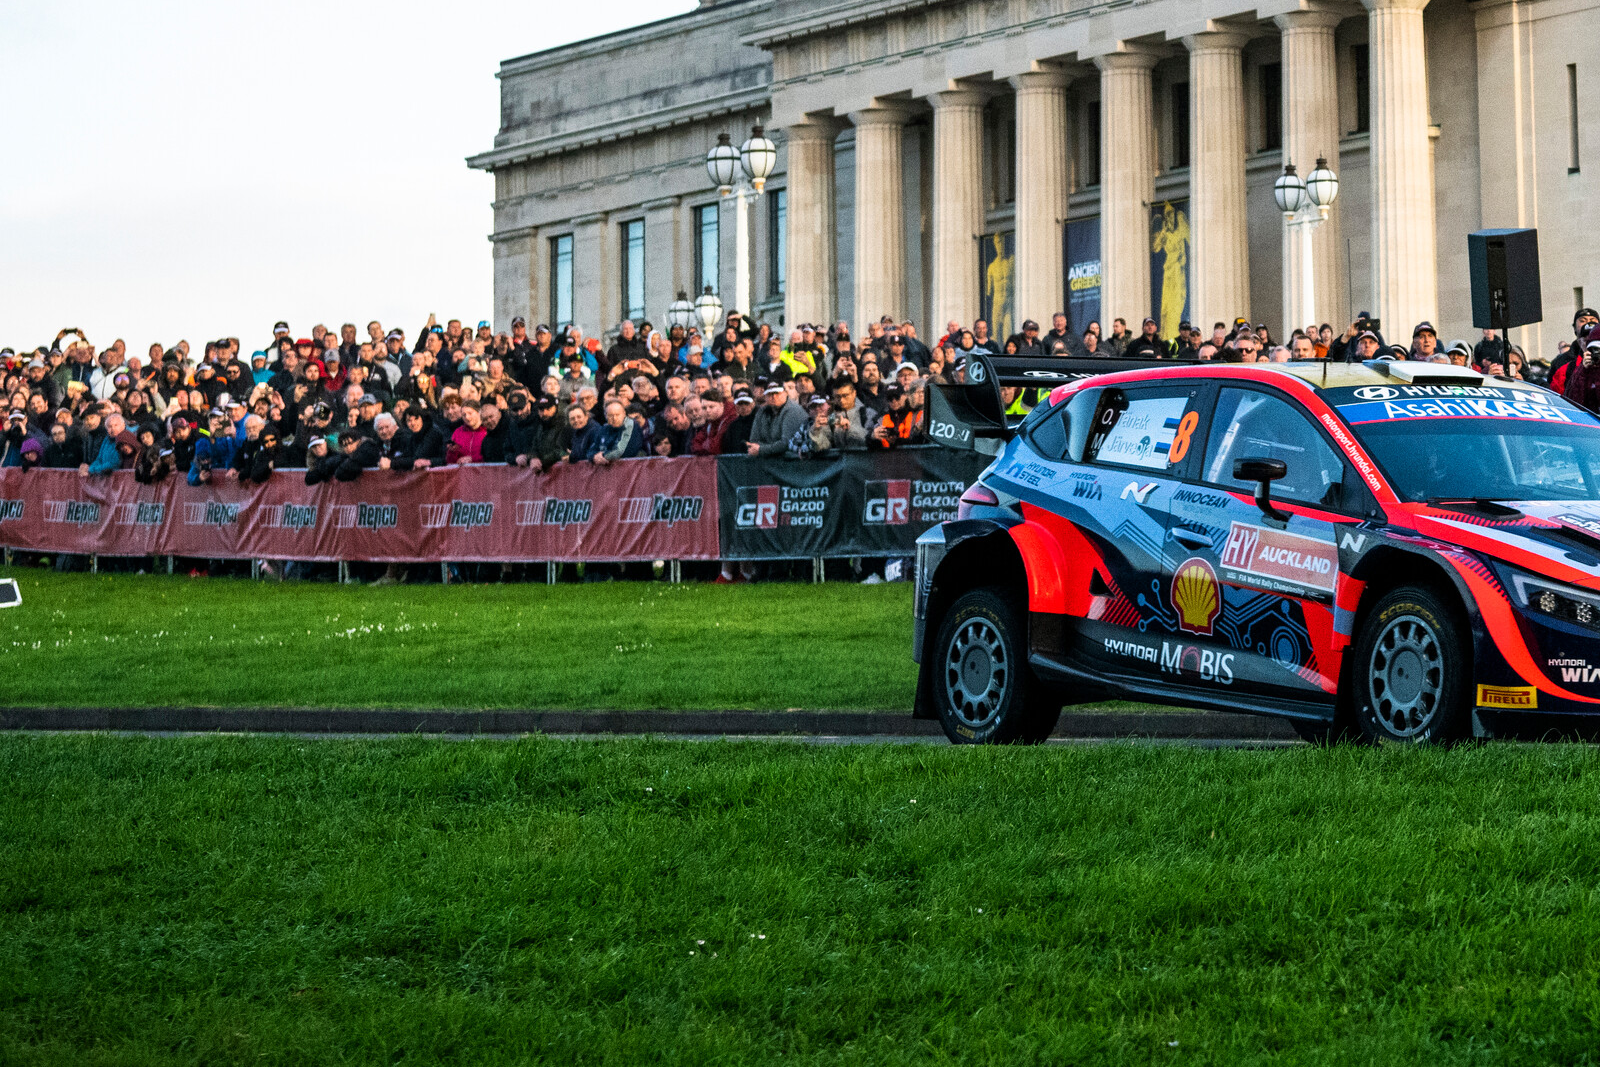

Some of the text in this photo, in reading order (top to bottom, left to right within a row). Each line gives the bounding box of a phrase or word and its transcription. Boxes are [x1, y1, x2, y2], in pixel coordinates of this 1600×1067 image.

[1401, 386, 1504, 399] HYUNDAI
[1385, 399, 1572, 423] AsahiKASEI
[929, 420, 955, 439] i20
[1101, 408, 1151, 441] O. Tänak
[1106, 436, 1154, 461] Järveoja
[1169, 410, 1200, 464] 8
[1321, 412, 1381, 492] motorsport.hyundai.com
[1019, 471, 1042, 487] STEEL
[1027, 462, 1058, 479] HYUNDAI
[1069, 472, 1098, 480] HYUNDAI
[781, 486, 829, 499] TOYOTA
[912, 480, 965, 493] TOYOTA
[651, 493, 704, 527] Repco
[781, 500, 825, 512] GAZOO
[865, 498, 908, 522] GR
[912, 495, 961, 508] GAZOO
[1173, 490, 1231, 508] INNOCEAN
[66, 500, 100, 527] Repco
[136, 501, 165, 530] Repco
[206, 501, 240, 529] Repco
[283, 502, 317, 532] Repco
[358, 502, 398, 532] Repco
[451, 500, 494, 531] Repco
[544, 497, 593, 530] Repco
[736, 503, 778, 527] GR
[781, 513, 824, 529] Racing
[1258, 549, 1331, 574] AUCKLAND
[1104, 638, 1235, 685] HYUNDAI MOBIS
[1548, 659, 1586, 667] HYUNDAI
[1482, 688, 1531, 704] PIRELLI
